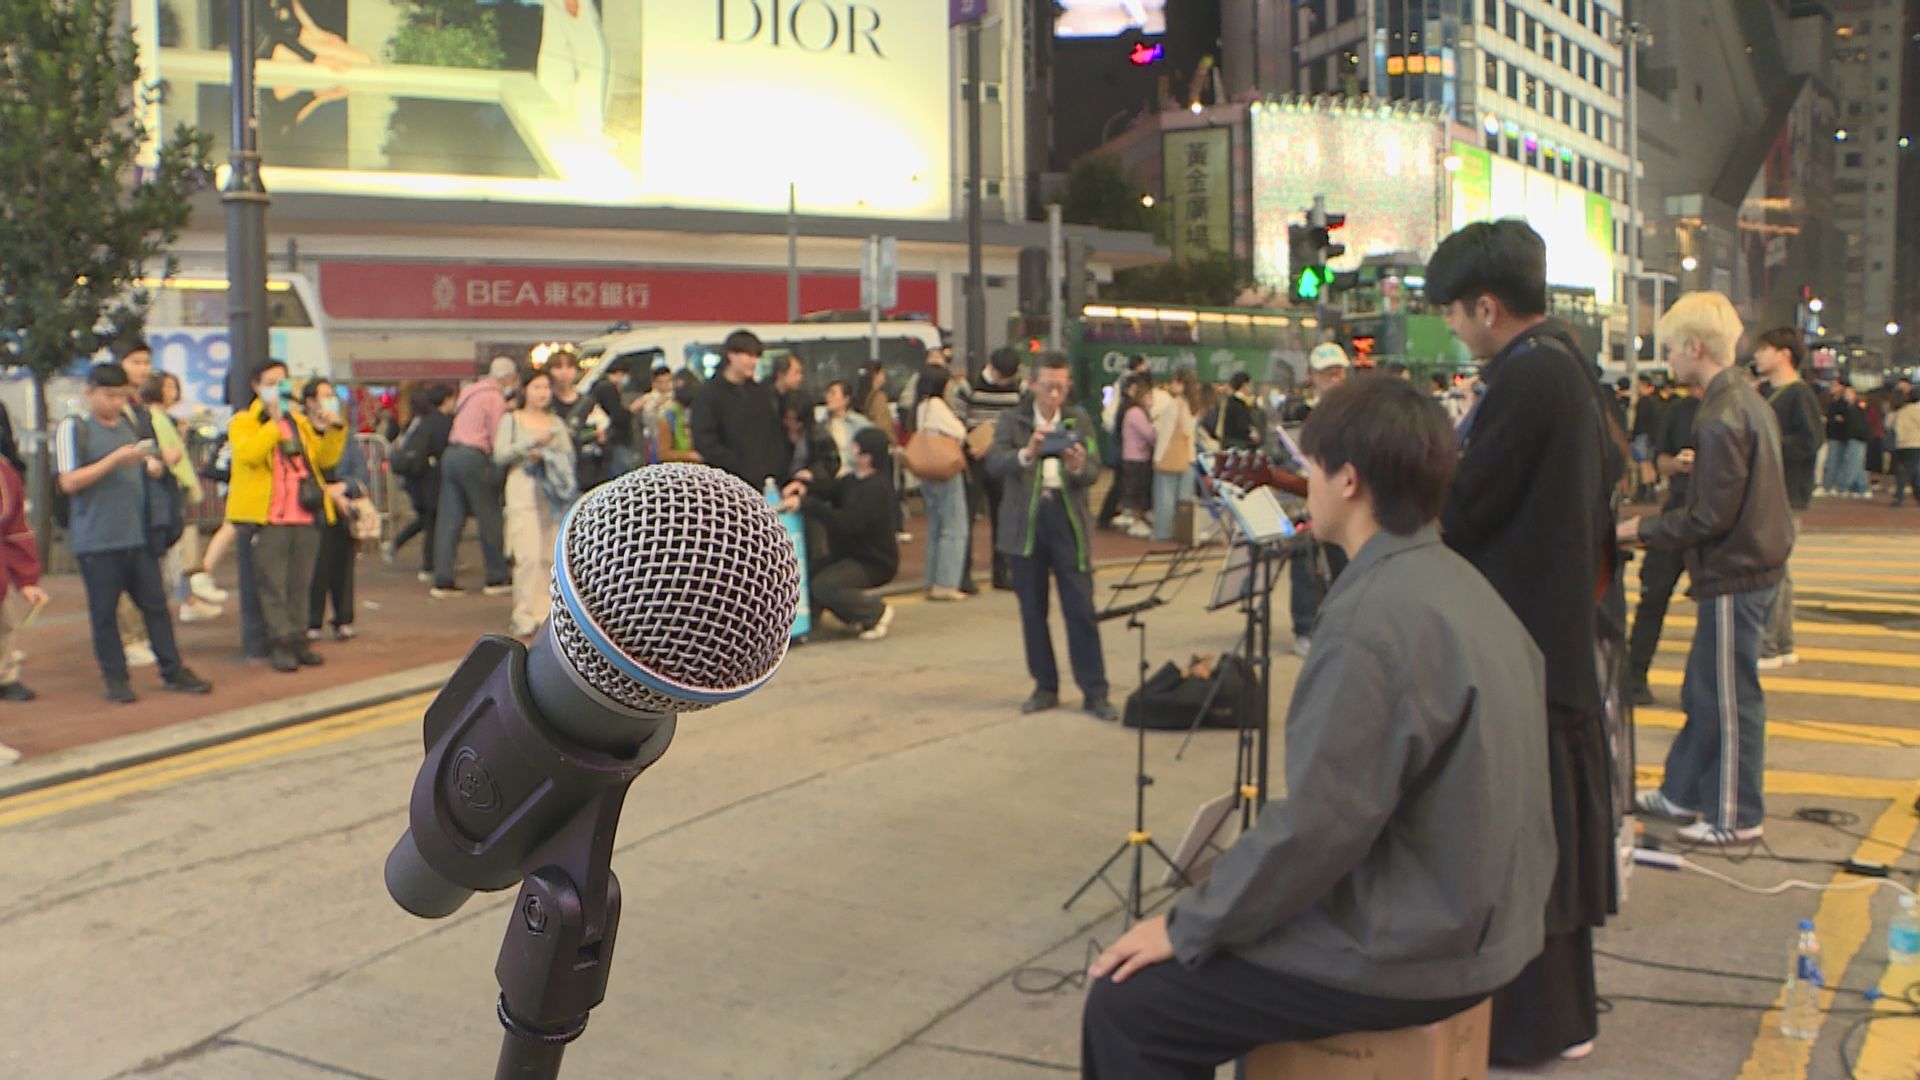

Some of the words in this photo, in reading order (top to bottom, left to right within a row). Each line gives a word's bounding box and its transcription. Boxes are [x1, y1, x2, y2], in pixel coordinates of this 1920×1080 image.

[715, 0, 884, 58] DIOR
[466, 279, 539, 307] BEA
[543, 280, 649, 308] 東亞銀行
